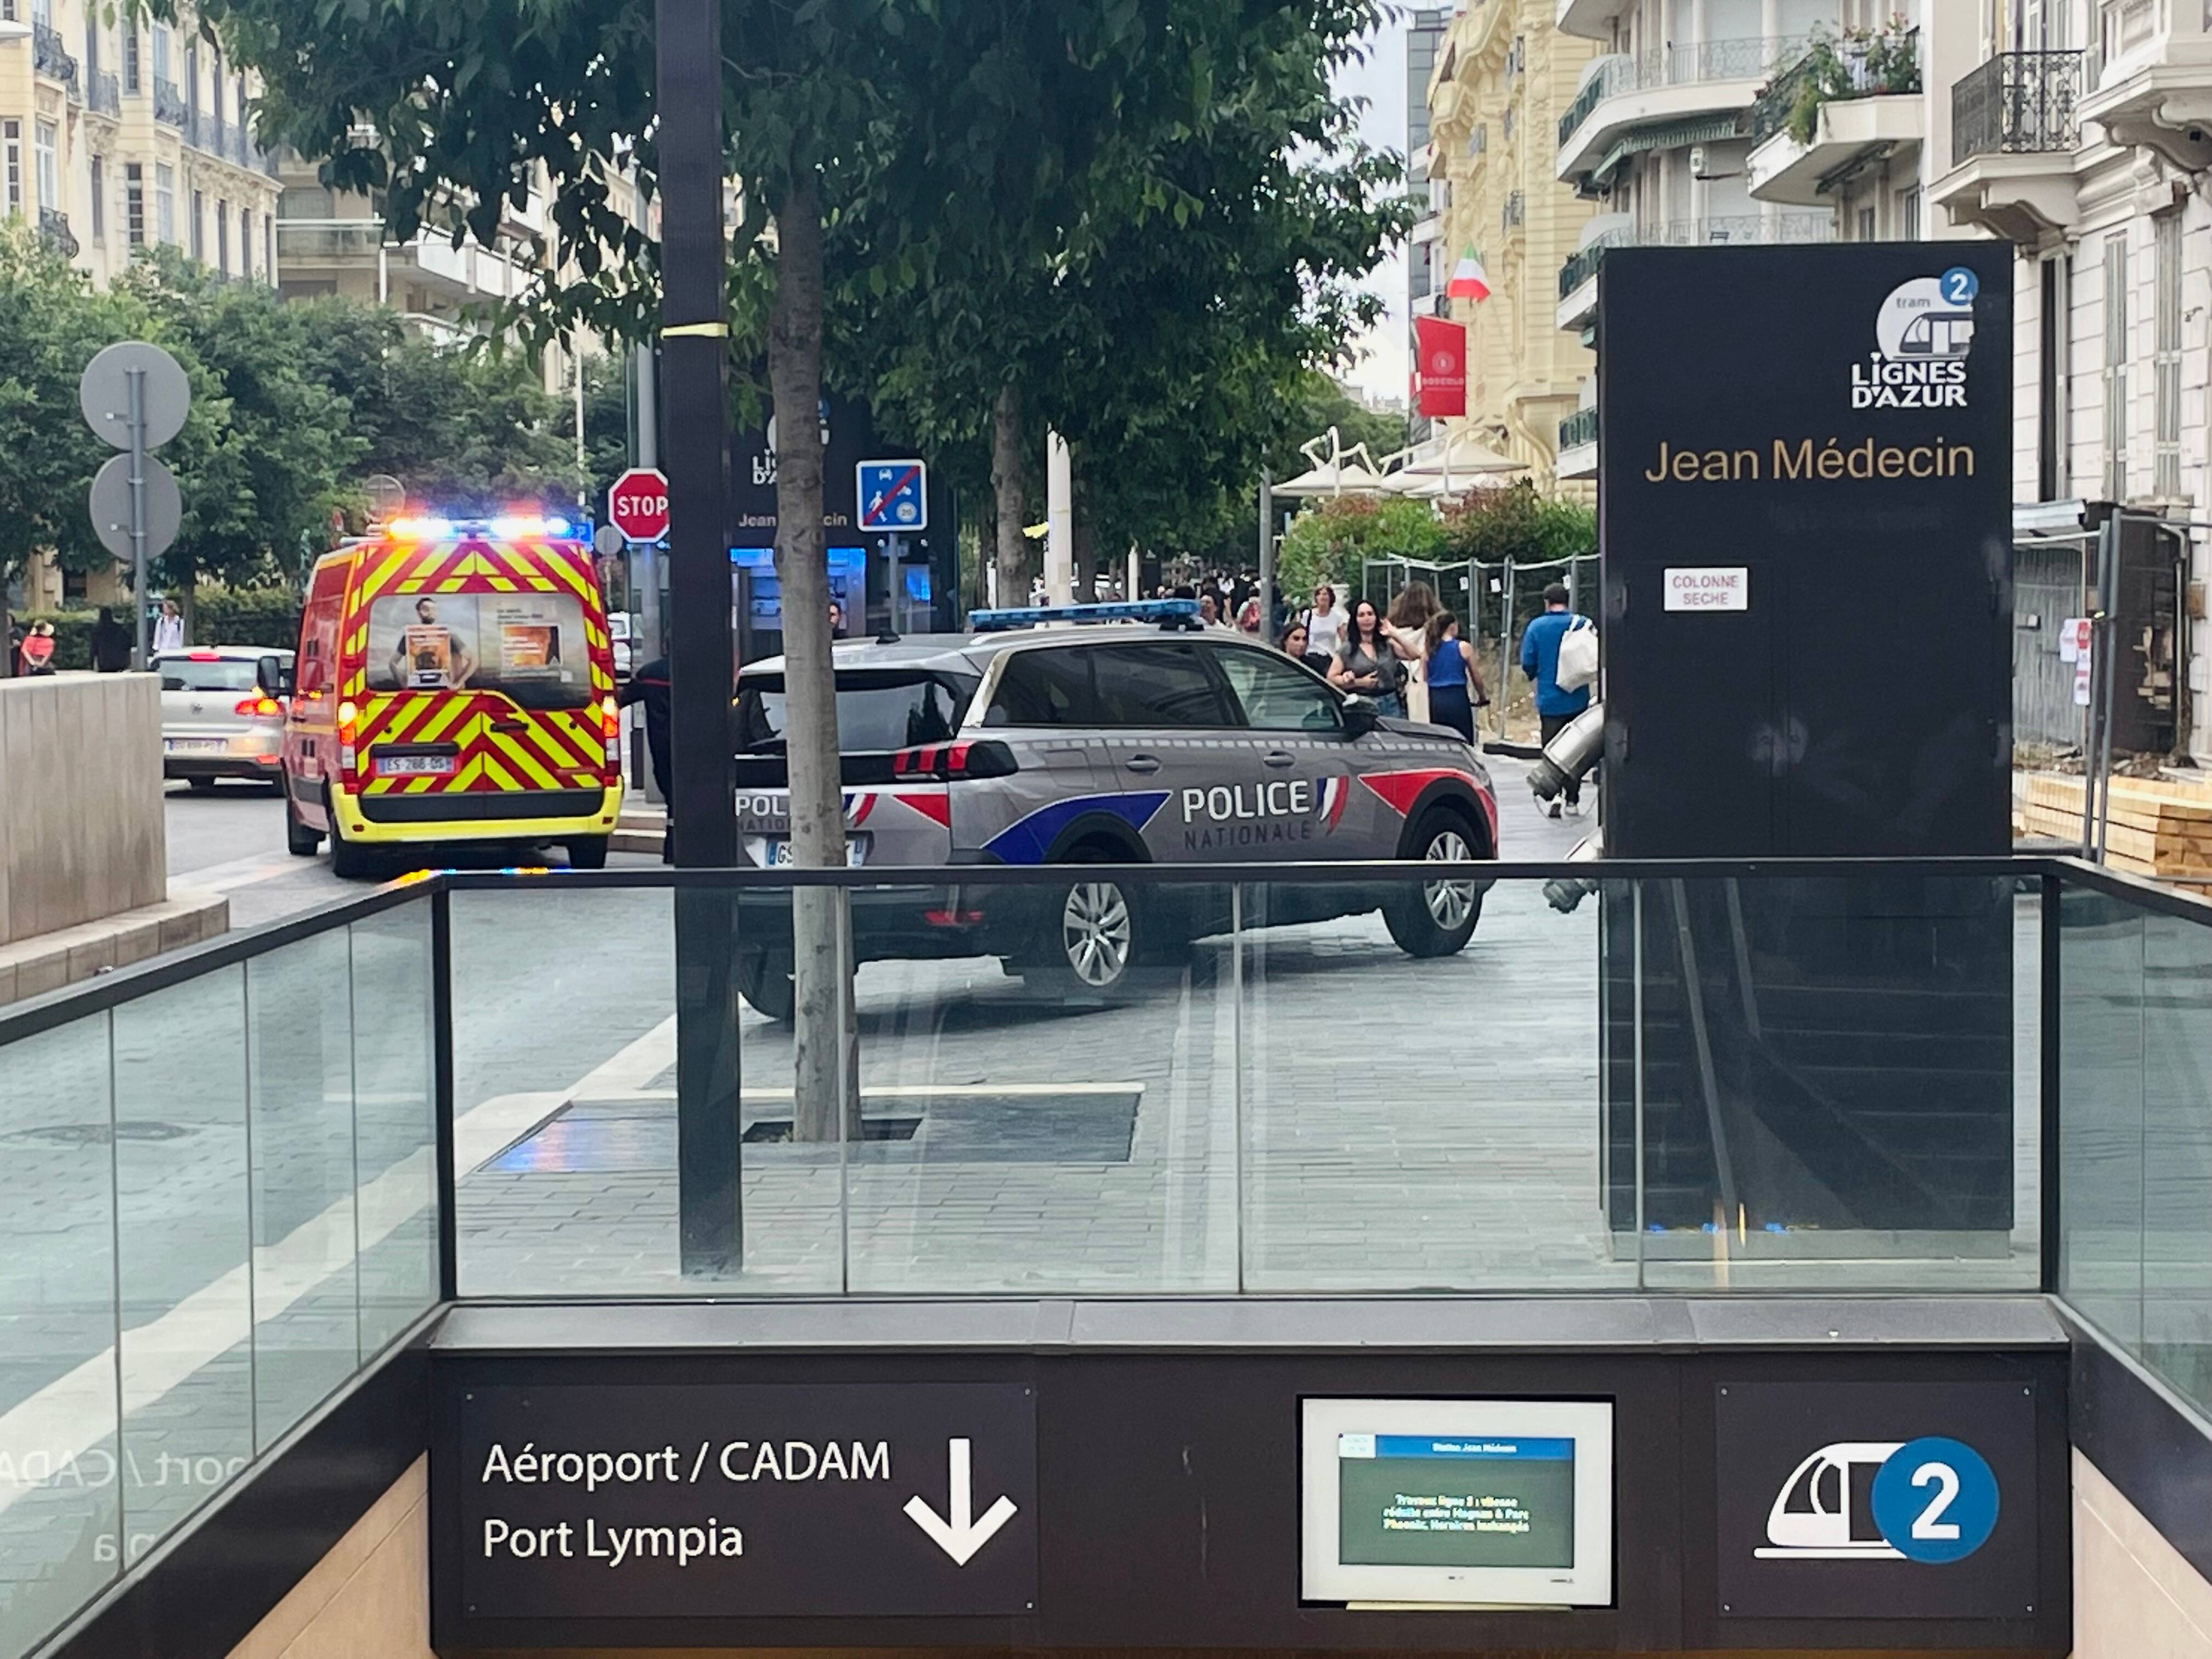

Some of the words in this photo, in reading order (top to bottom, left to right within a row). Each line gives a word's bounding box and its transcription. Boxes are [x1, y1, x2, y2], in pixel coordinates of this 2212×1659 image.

[1950, 273, 1970, 301] 2
[1896, 297, 1931, 308] tram
[1852, 352, 1967, 386] LIGNES
[1852, 385, 1968, 409] D'AZUR
[1646, 441, 1760, 483] Jean
[1773, 437, 1974, 480] Médecin
[617, 495, 669, 517] STOP
[1673, 575, 1739, 588] COLONNE
[1683, 592, 1729, 605] SECHE
[736, 795, 787, 816] POL
[1183, 781, 1310, 822] POLICE
[1184, 822, 1311, 850] NATIONALE
[482, 1443, 680, 1491] Aéroport
[689, 1442, 710, 1483] /
[720, 1441, 891, 1481] CADAM
[1911, 1462, 1960, 1539] 2
[484, 1519, 573, 1556] Port
[587, 1517, 743, 1566] Lympia
